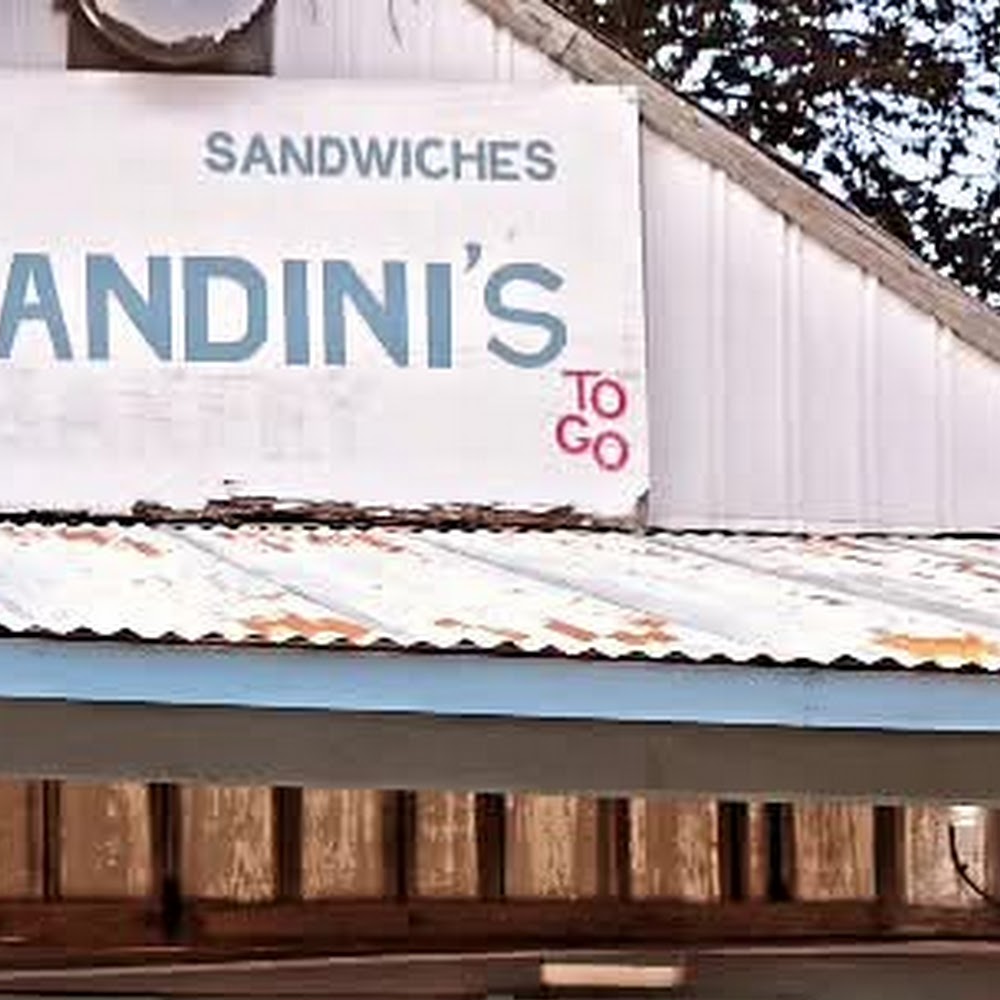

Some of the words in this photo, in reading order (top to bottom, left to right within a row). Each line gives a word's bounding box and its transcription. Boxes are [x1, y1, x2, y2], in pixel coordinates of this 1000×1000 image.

[203, 130, 558, 182] SANDWICHES
[561, 368, 628, 422] TO
[555, 415, 631, 473] GO
